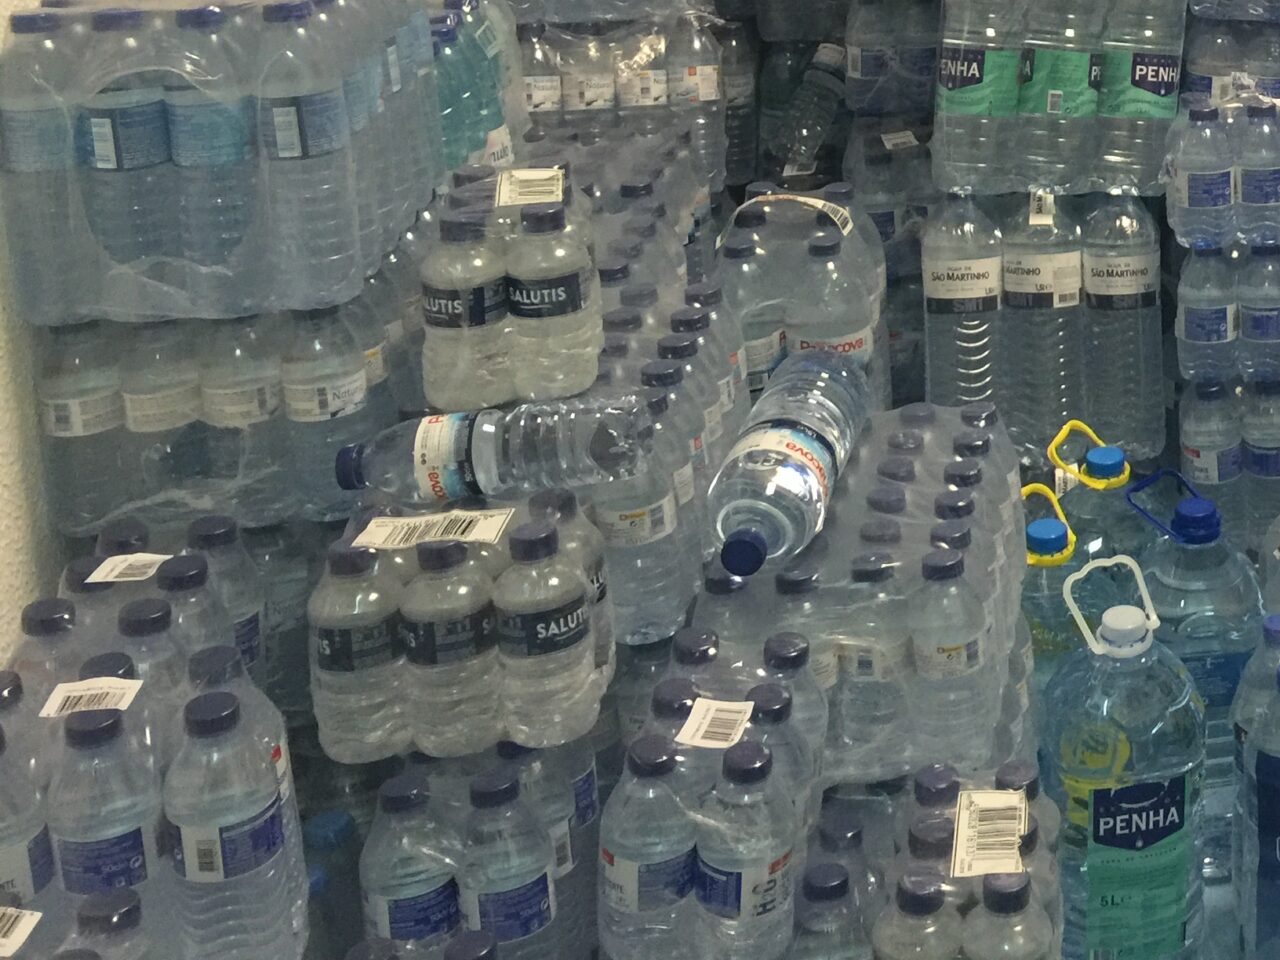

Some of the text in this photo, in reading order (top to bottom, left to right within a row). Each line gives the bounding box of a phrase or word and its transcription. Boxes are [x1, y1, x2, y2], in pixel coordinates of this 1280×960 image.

[946, 270, 990, 282] MARTINHO
[1106, 267, 1149, 278] MARTINHO
[509, 287, 567, 303] SALUTIS
[1099, 806, 1180, 837] PENHA
